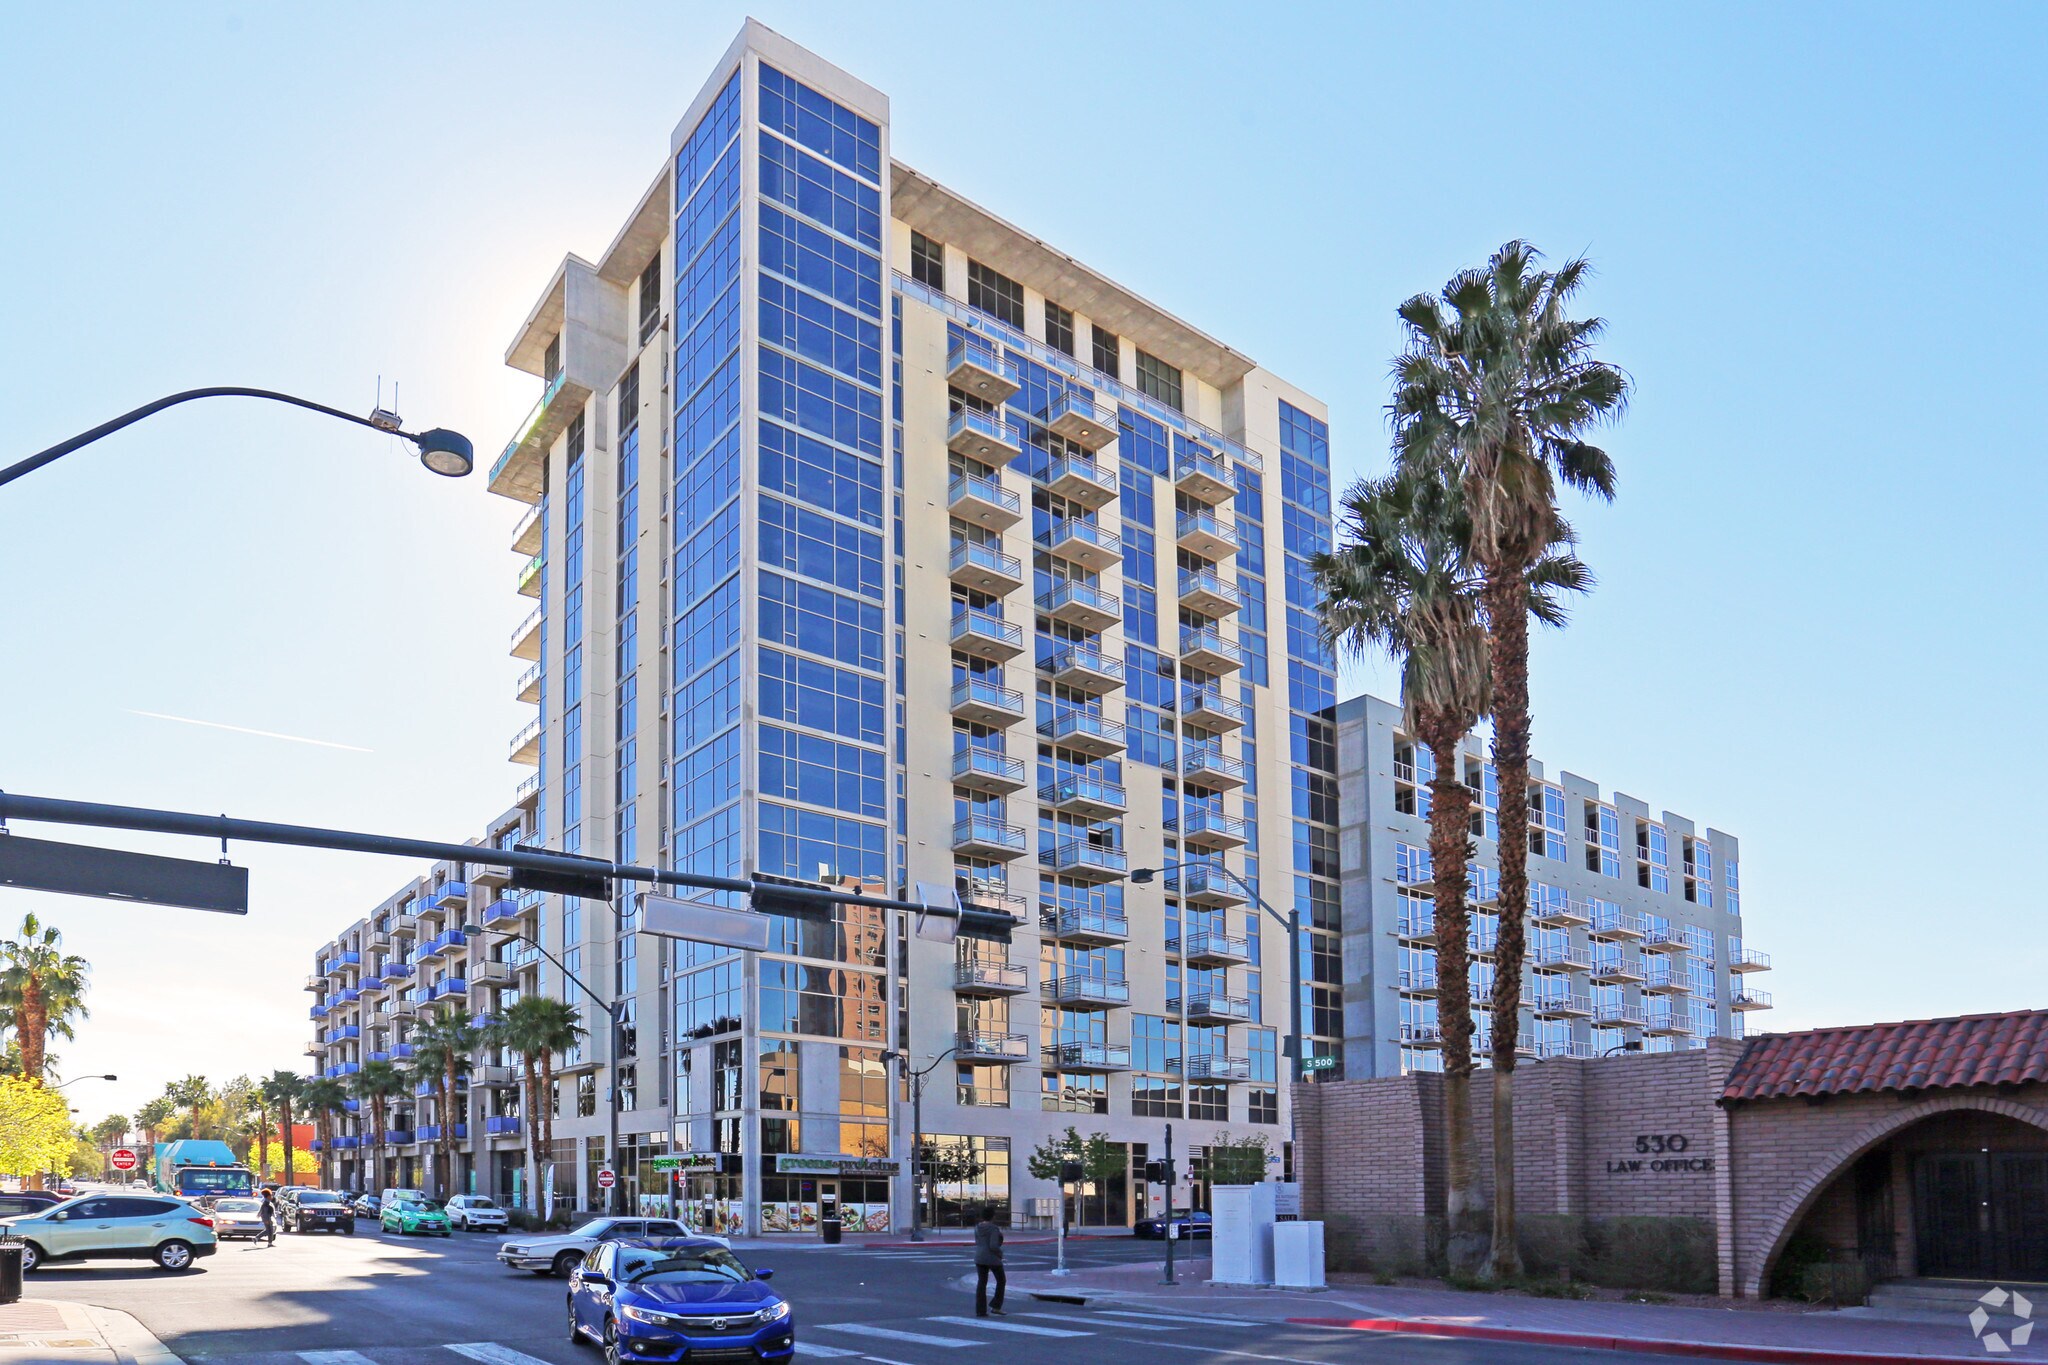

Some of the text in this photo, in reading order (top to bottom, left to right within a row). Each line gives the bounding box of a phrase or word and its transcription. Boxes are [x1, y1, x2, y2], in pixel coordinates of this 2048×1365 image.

[1315, 1058, 1332, 1067] 500
[1635, 1134, 1688, 1153] 530
[1606, 1160, 1640, 1173] LAW
